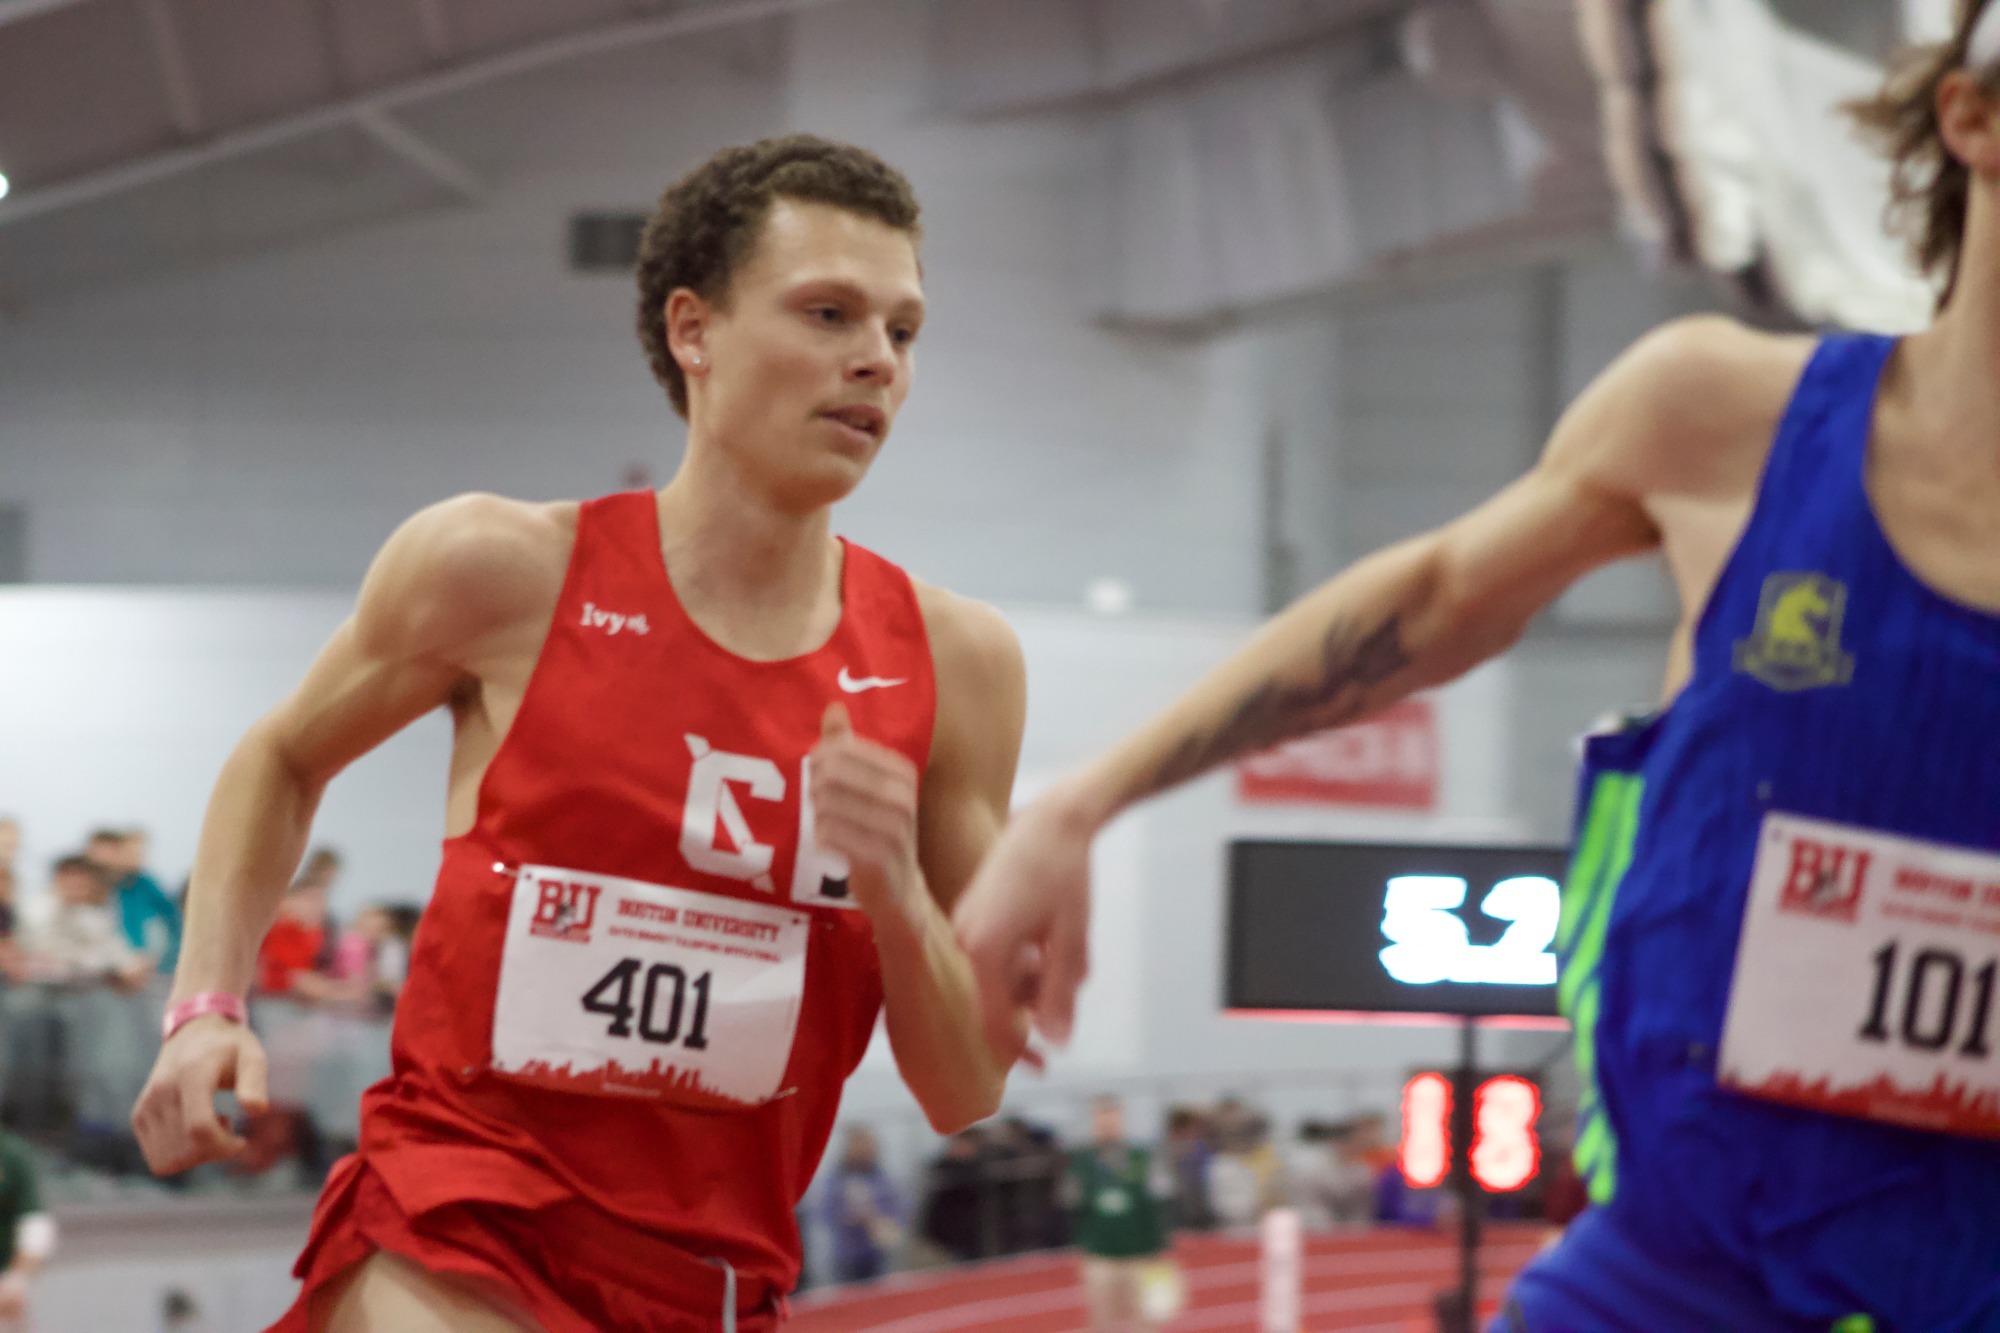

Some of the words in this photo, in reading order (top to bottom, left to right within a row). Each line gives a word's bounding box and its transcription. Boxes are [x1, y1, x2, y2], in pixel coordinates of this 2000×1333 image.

[580, 602, 626, 635] Ivy
[531, 879, 602, 933] BU
[1779, 838, 1872, 915] BU
[580, 957, 712, 1050] 401
[1856, 939, 1999, 1060] 101
